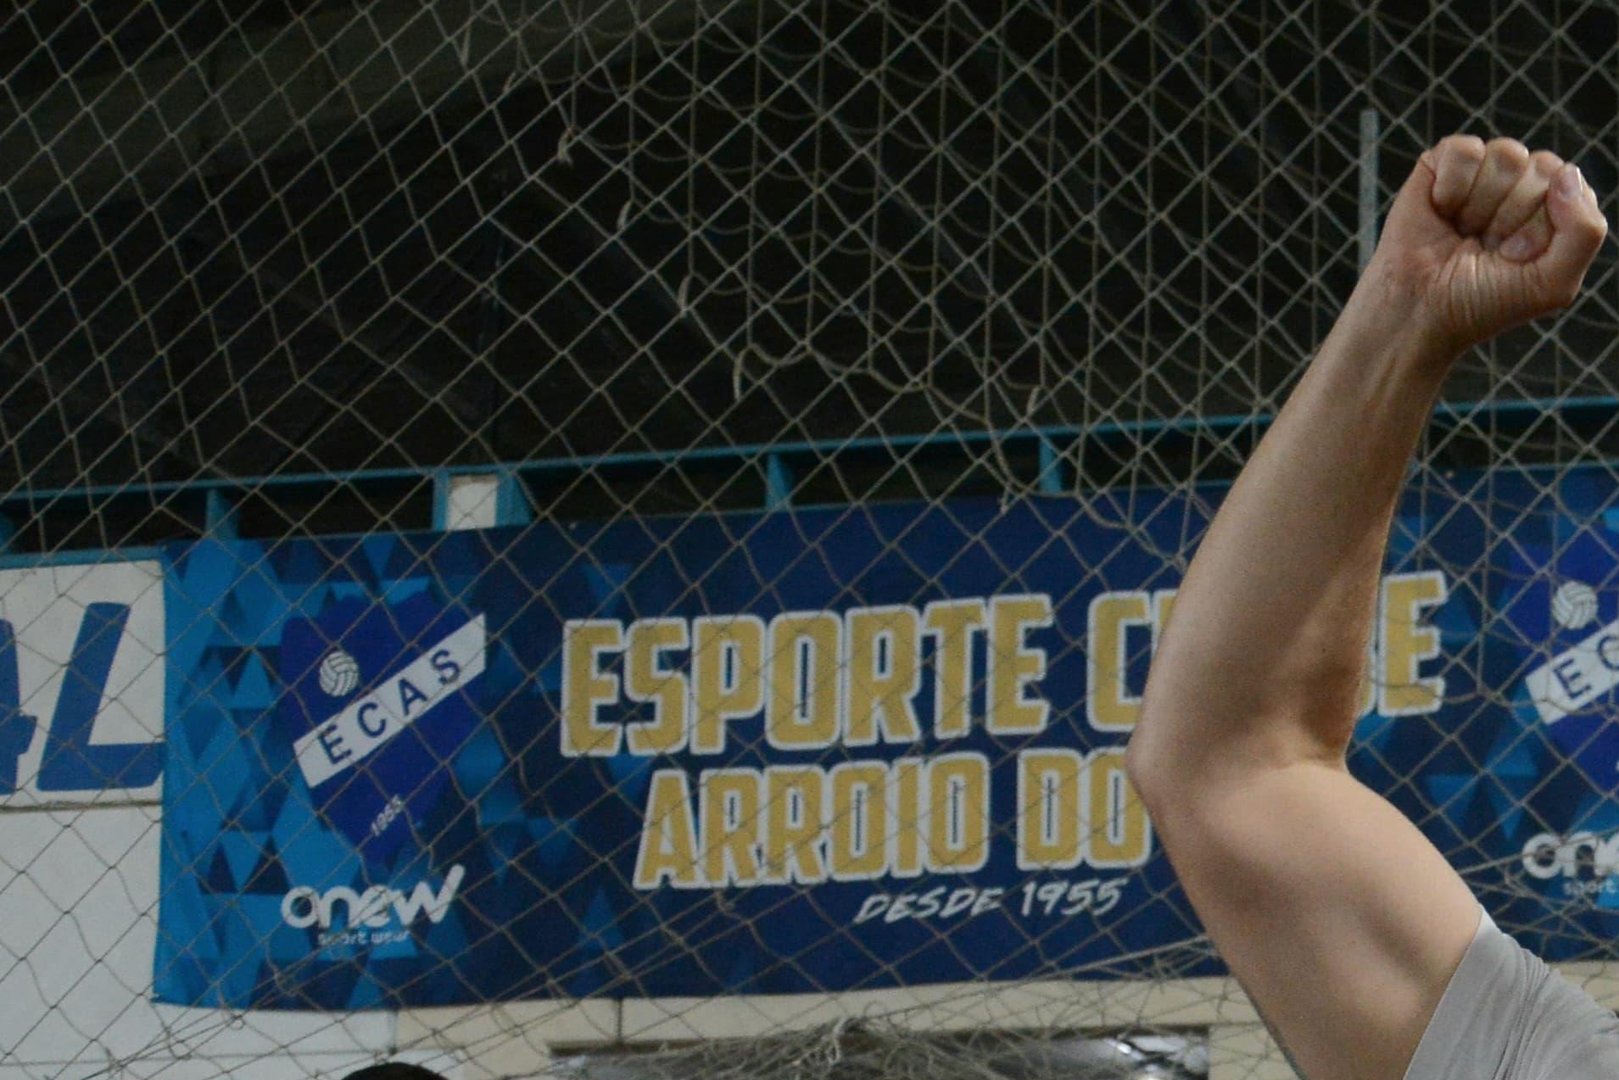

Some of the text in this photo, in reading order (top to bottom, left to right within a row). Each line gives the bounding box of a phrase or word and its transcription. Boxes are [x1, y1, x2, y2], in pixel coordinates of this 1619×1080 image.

[317, 648, 461, 765] ECAS
[560, 594, 1053, 758] ESPORTE
[632, 746, 1152, 890] ARROIO DO
[280, 863, 466, 929] onew
[853, 877, 1129, 924] DESDE 1955
